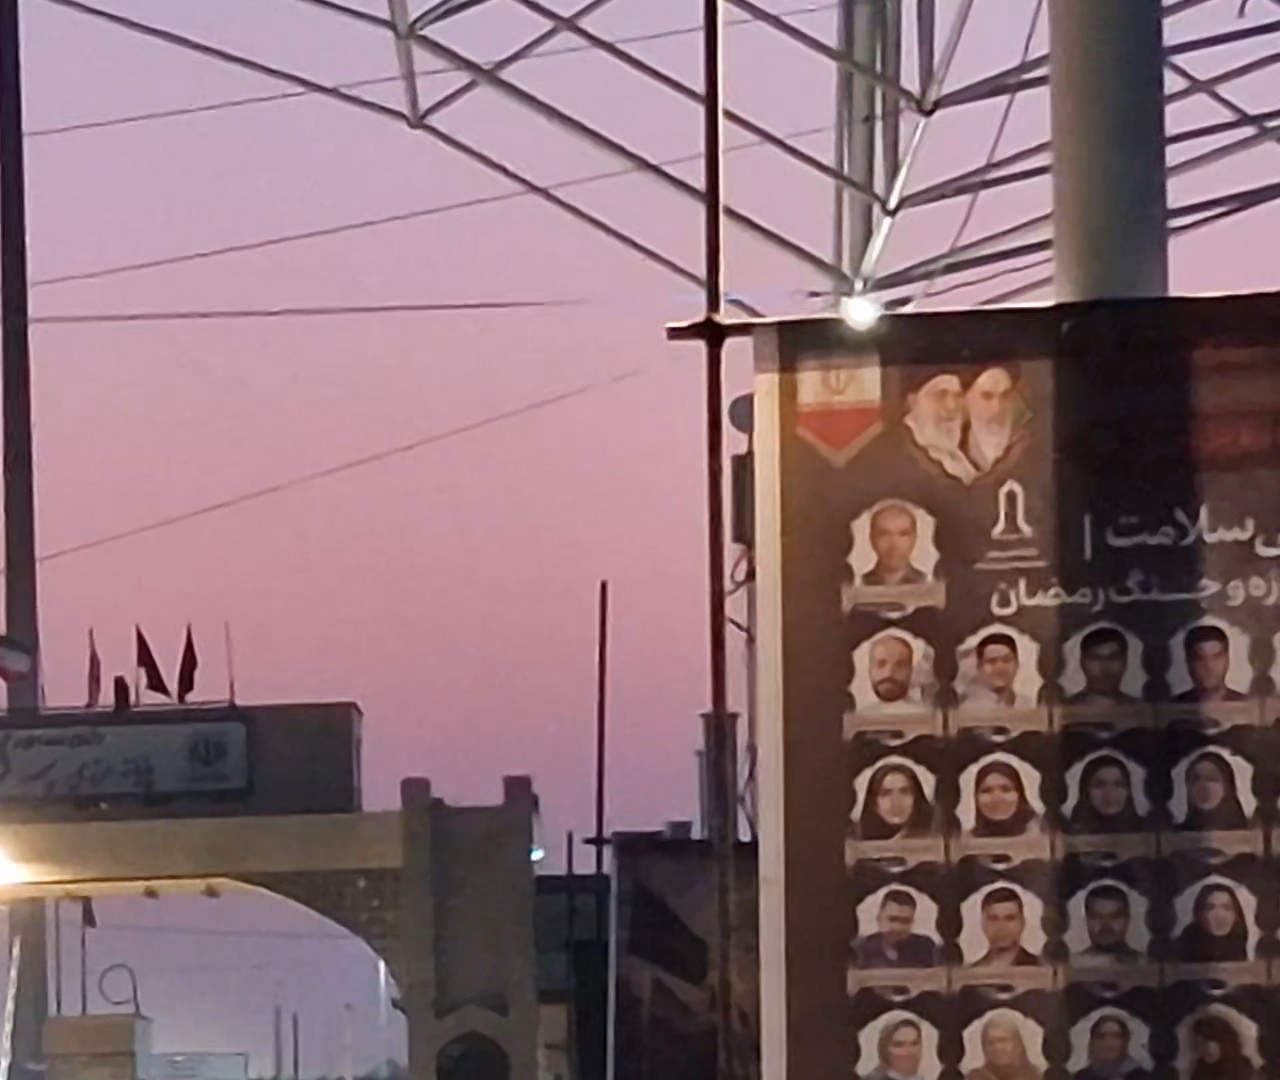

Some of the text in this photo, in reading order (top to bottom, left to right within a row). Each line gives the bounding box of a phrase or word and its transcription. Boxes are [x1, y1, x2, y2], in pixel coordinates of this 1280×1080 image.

[1105, 503, 1256, 548] سلامت
[989, 575, 1106, 617] رمضان
[1108, 569, 1222, 610] جنگ
[1225, 577, 1246, 607] و
